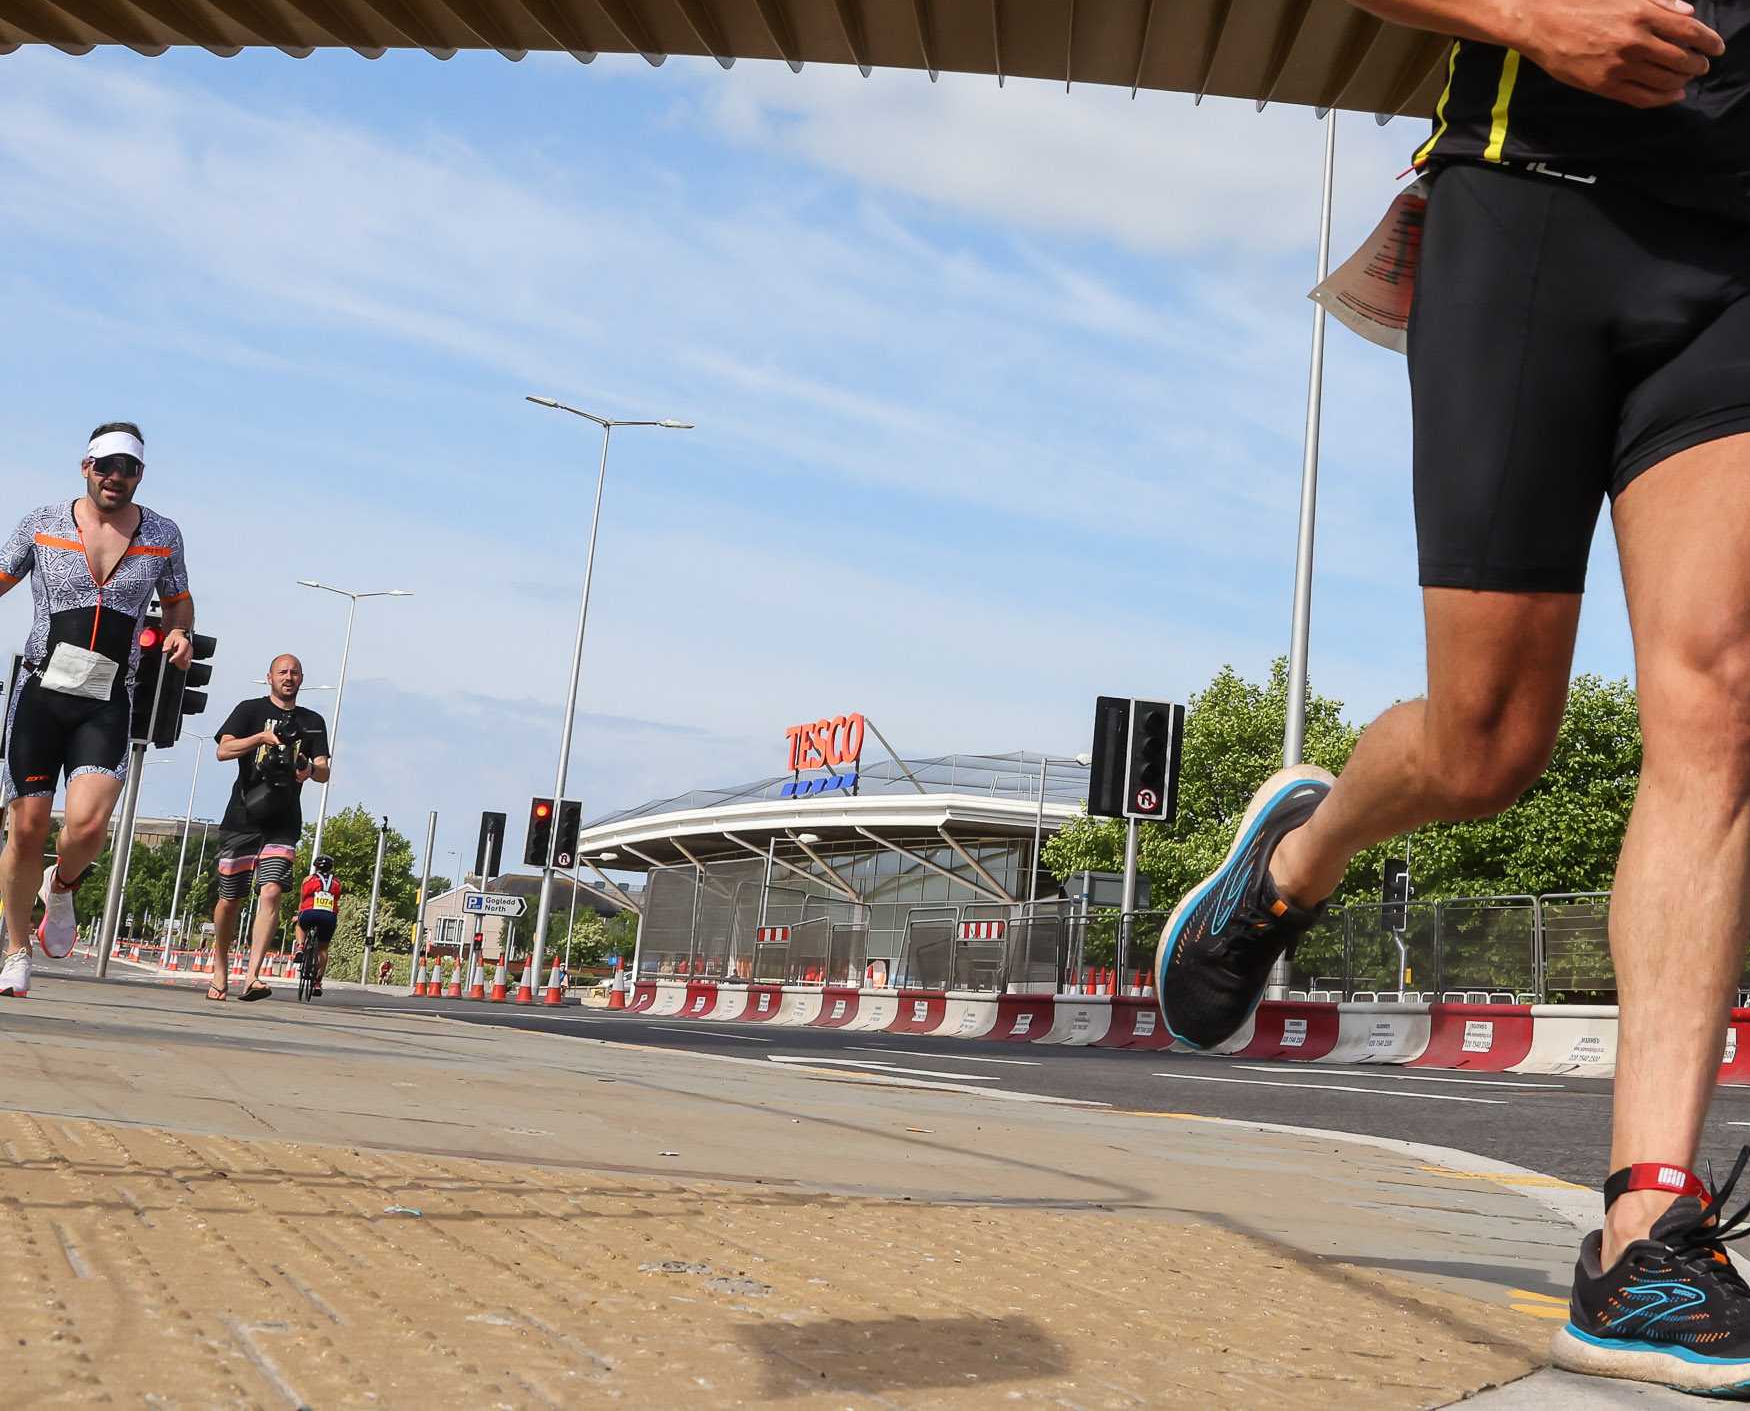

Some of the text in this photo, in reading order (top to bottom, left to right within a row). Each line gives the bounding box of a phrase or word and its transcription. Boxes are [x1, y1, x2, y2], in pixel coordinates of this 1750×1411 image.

[785, 712, 864, 771] TESCO
[316, 898, 333, 906] 1074
[486, 897, 516, 905] Gogledd
